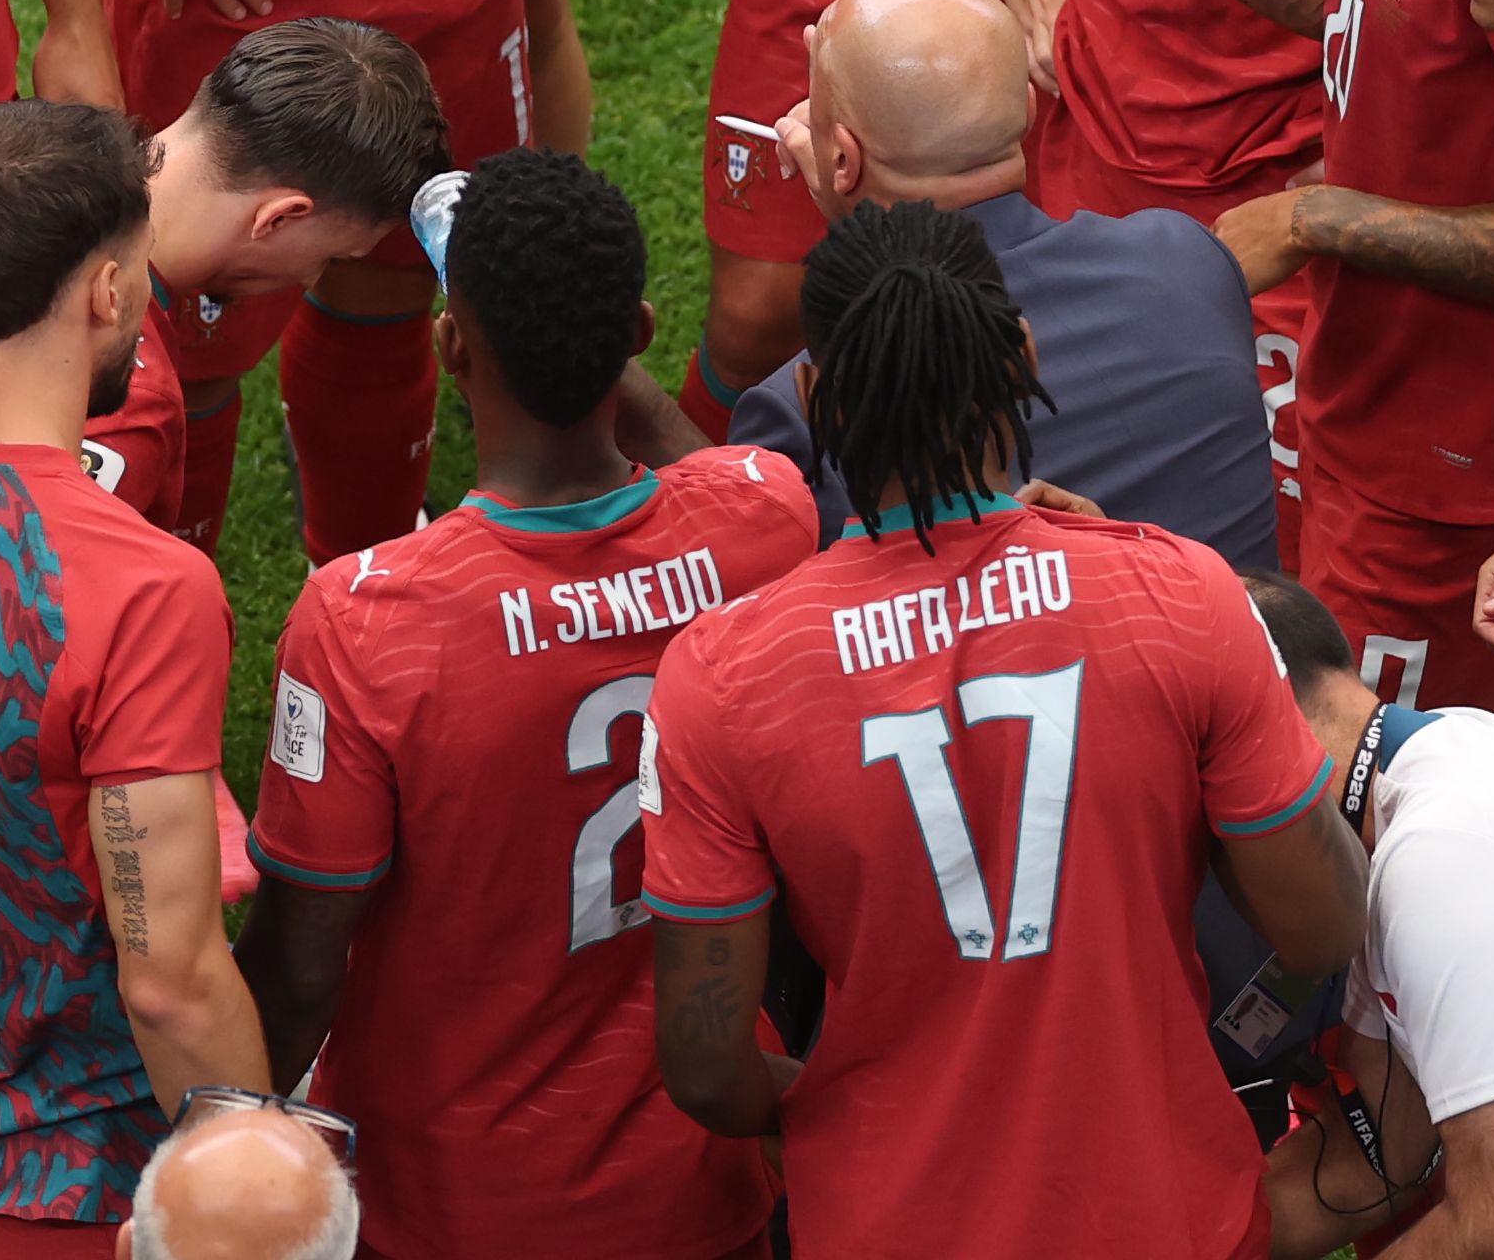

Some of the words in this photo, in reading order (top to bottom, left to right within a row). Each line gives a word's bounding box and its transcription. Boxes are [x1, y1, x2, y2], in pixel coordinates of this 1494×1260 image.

[498, 587, 549, 657] N.
[551, 547, 724, 643] SEMEDO
[832, 586, 954, 675] RAFA
[957, 544, 1072, 633] LEÃO
[861, 658, 1084, 963] 17
[1346, 749, 1373, 813] 2026
[1349, 1109, 1374, 1145] FIFA
